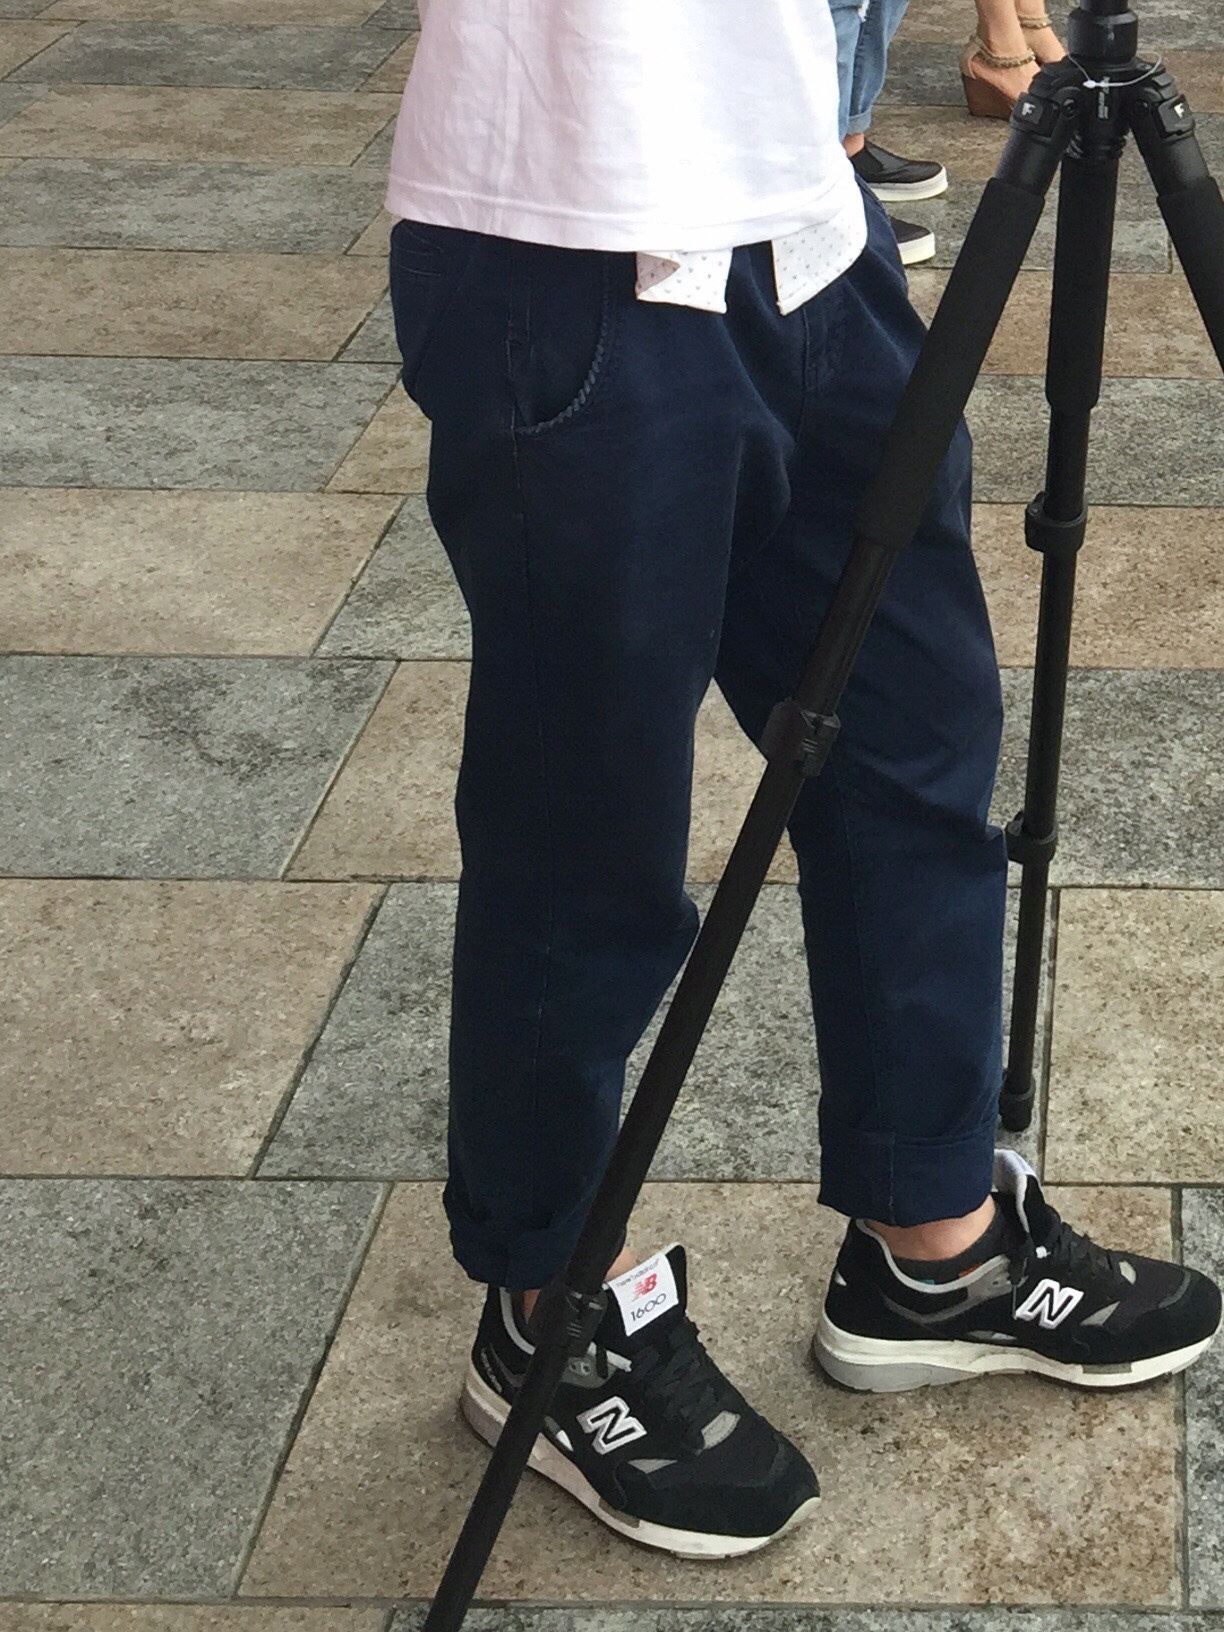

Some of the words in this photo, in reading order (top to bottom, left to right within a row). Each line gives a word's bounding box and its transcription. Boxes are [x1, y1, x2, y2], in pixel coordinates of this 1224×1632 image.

[630, 1293, 667, 1322] 1600
[1015, 1278, 1085, 1329] N
[575, 1395, 648, 1455] N
